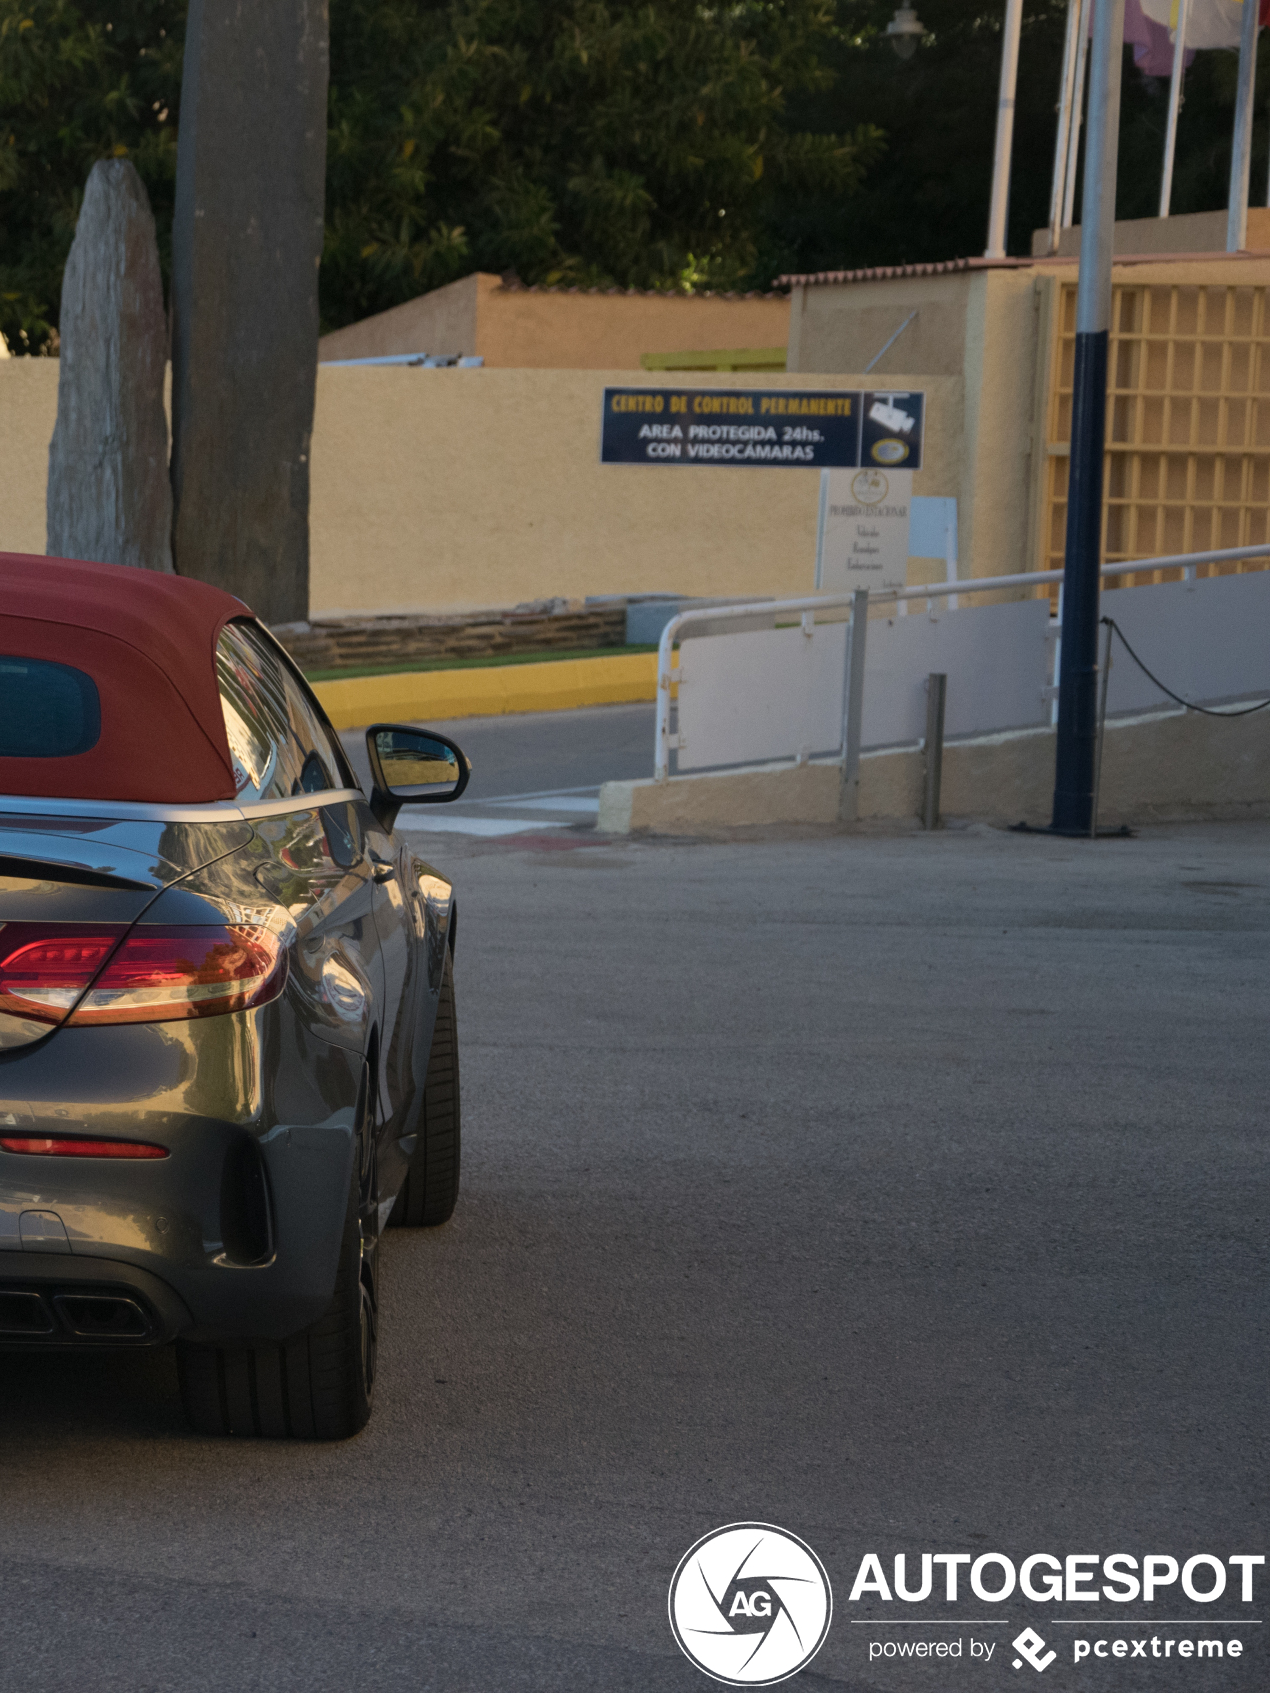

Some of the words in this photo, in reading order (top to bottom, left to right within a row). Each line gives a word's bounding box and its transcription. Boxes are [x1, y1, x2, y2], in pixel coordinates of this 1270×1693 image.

[611, 395, 664, 413] CENTRO
[670, 396, 687, 413] DE
[693, 396, 754, 414] CONTROL
[760, 397, 851, 416] PERMANENTE
[638, 424, 683, 439] AREA
[688, 425, 777, 441] PROTEGIDA
[647, 442, 681, 458] CON
[687, 441, 814, 461] VIDEOCÁMARAS
